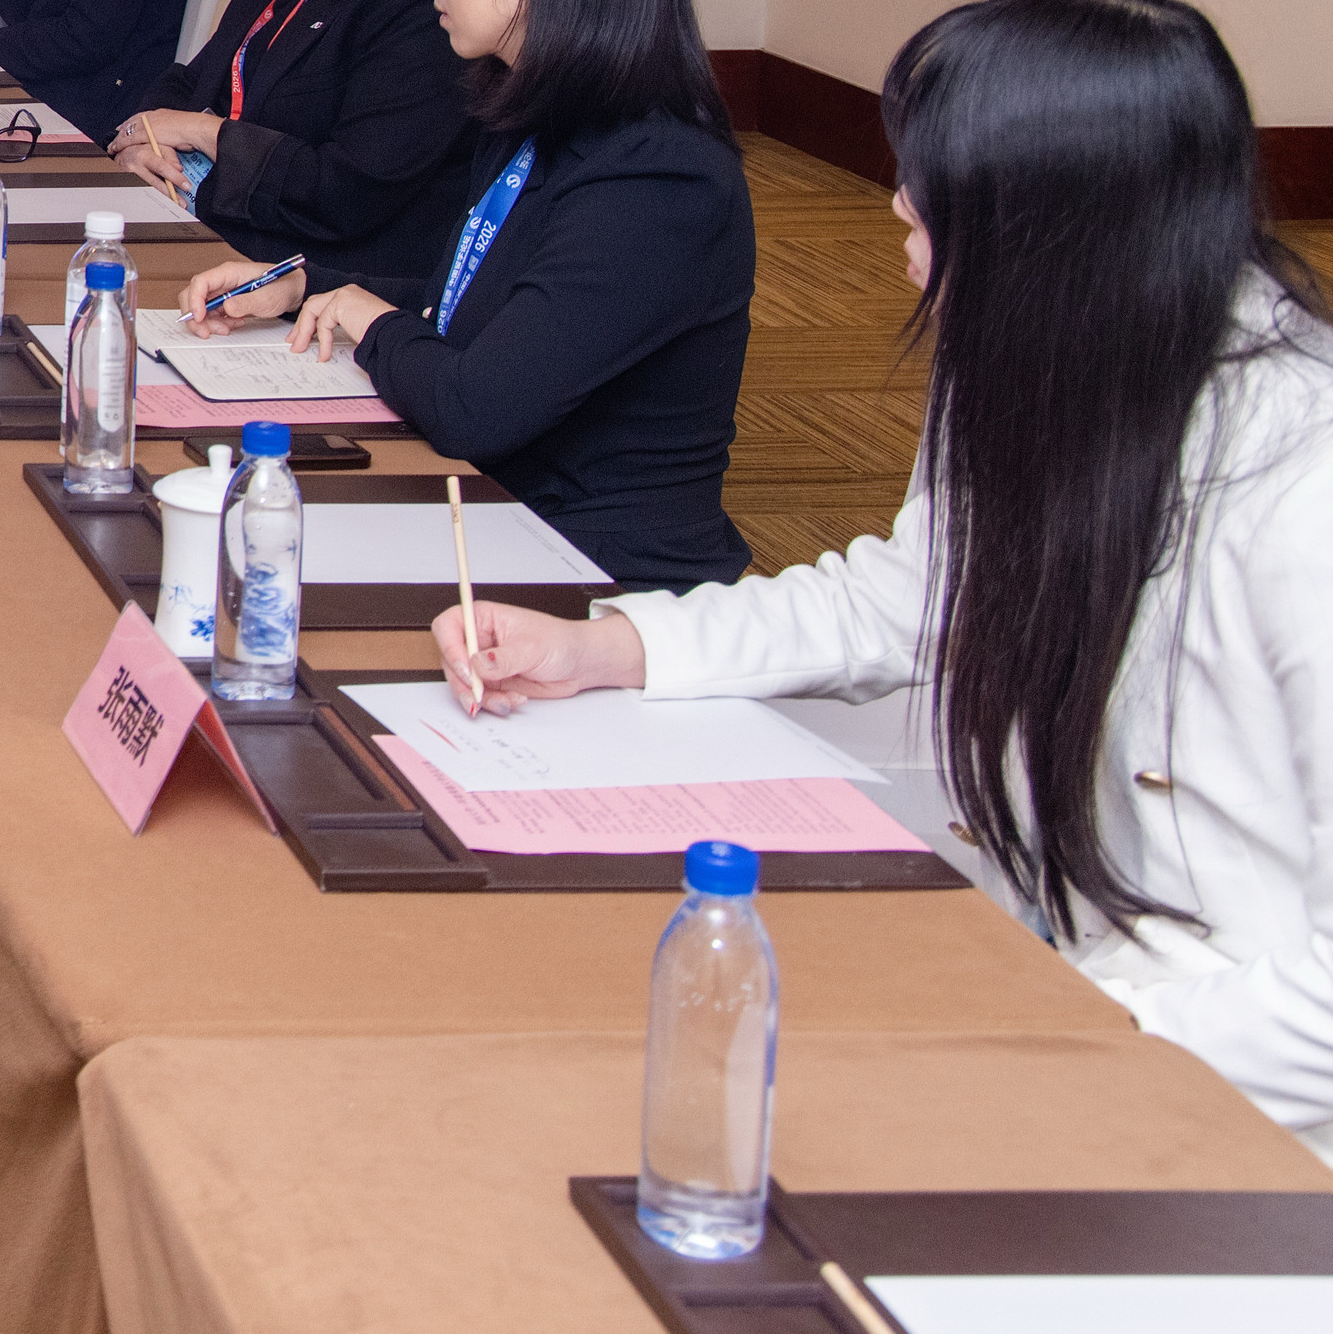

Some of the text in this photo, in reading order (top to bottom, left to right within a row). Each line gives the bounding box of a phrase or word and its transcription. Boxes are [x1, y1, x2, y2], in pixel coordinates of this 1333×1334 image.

[233, 70, 241, 93] 2026
[474, 220, 497, 254] 2026
[97, 665, 165, 768] 张雨默
